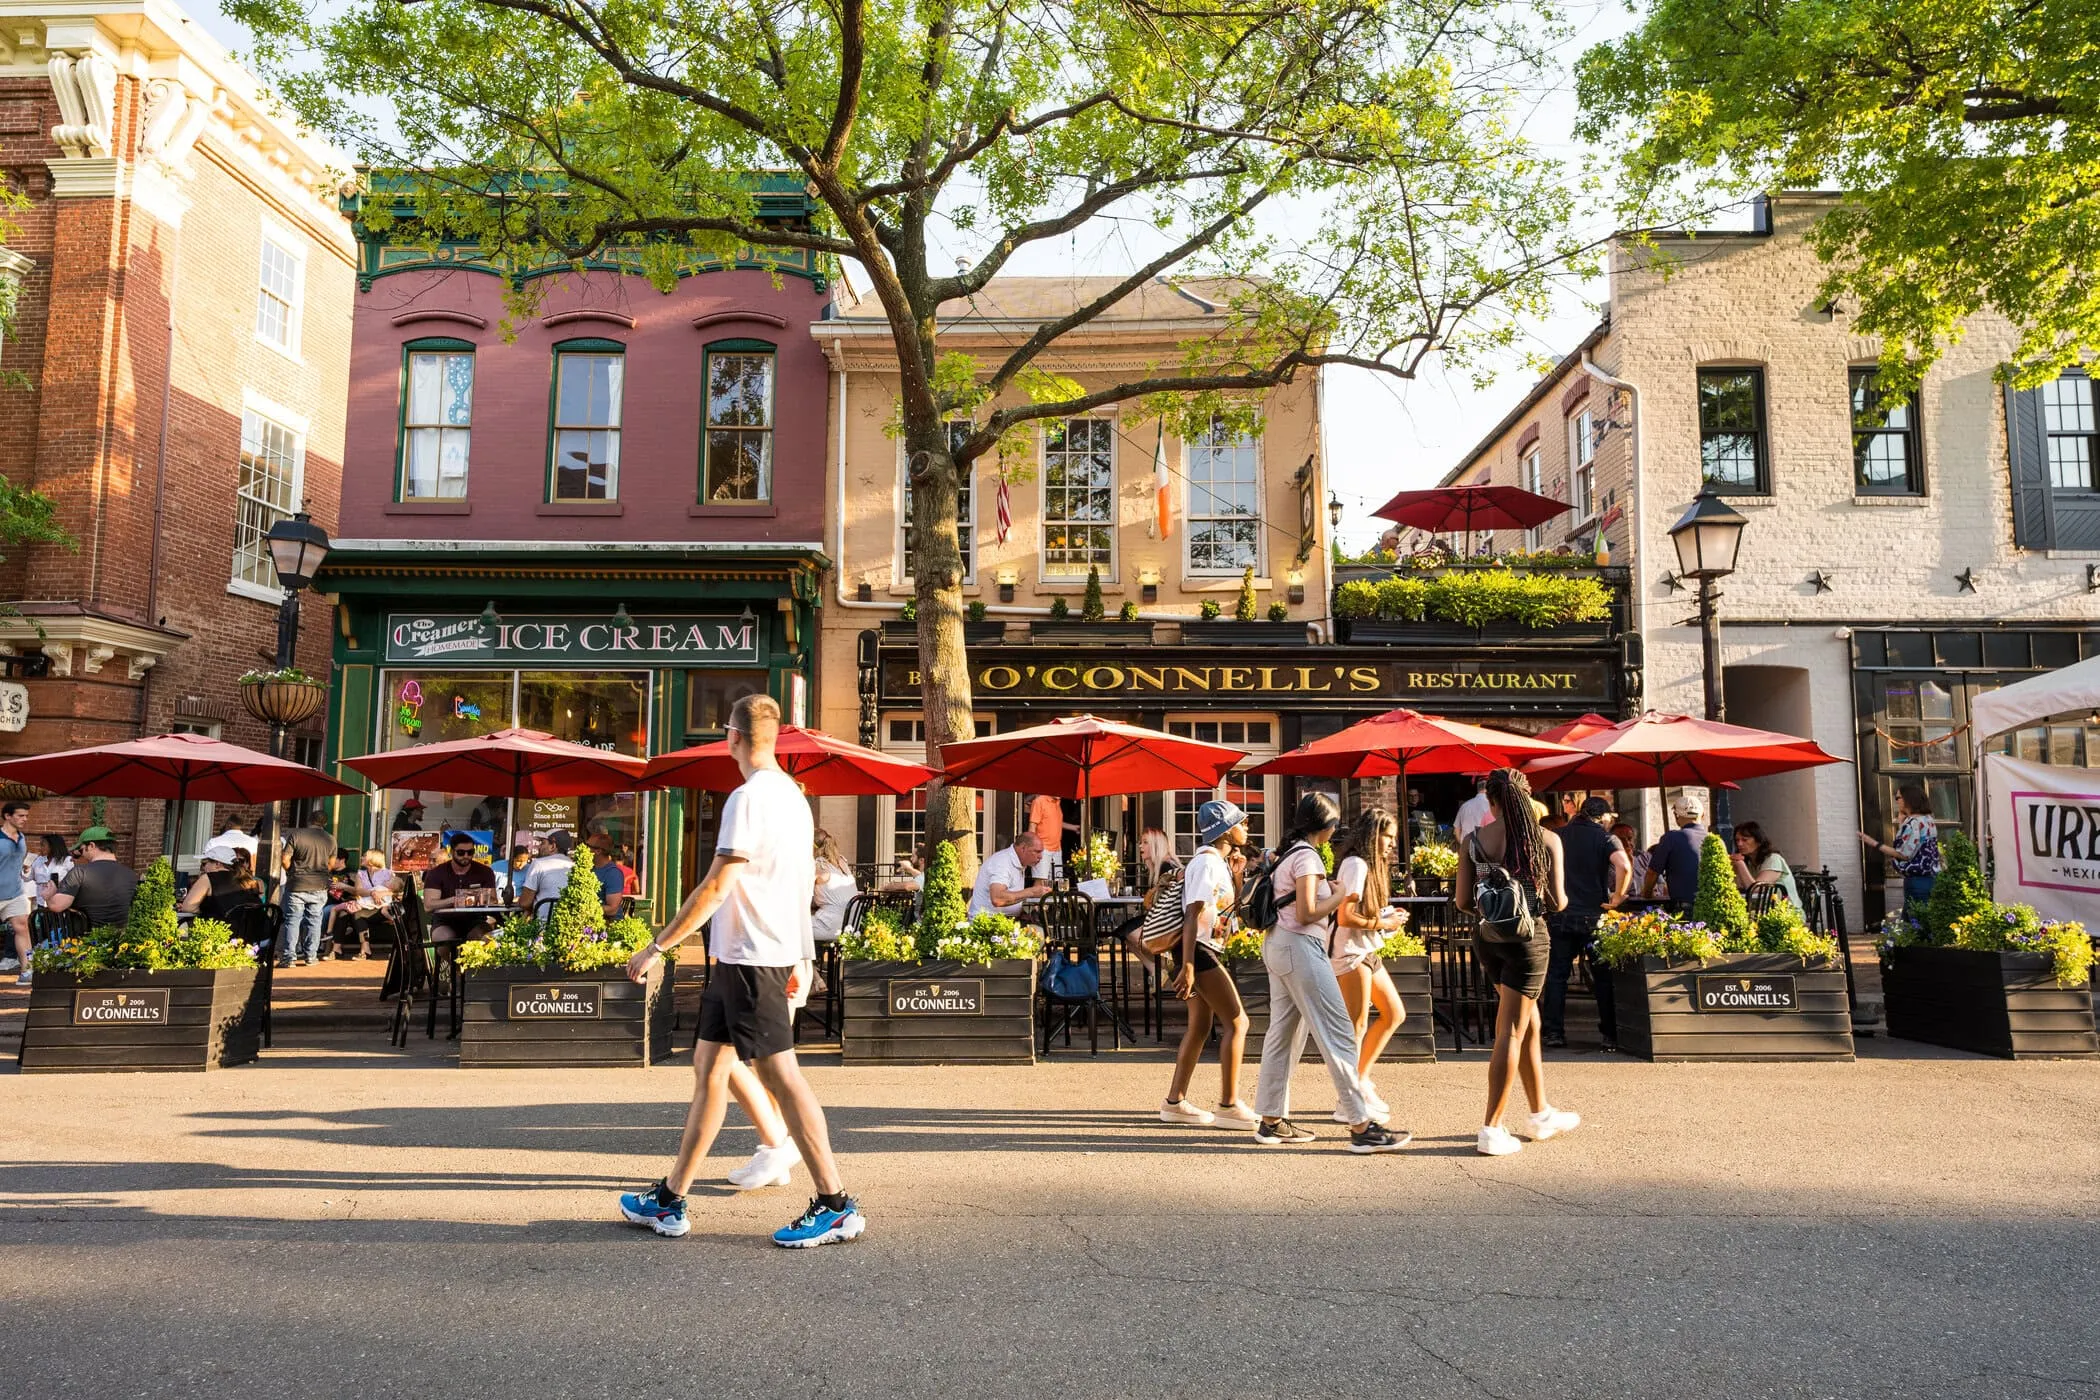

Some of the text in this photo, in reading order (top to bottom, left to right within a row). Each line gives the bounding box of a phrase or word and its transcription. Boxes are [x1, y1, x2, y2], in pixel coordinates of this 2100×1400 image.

[394, 618, 486, 647] Creamery
[495, 624, 754, 651] ICE CREAM
[427, 640, 477, 654] HOMEMADE
[979, 666, 1381, 692] O'CONNELL'S
[1408, 672, 1577, 689] RESTAURANT
[943, 990, 960, 998] 2006
[1705, 993, 1791, 1006] O'CONNELL'S
[516, 1001, 593, 1014] O'CONNELL'S
[896, 997, 976, 1010] O'CONNELL'S
[82, 1007, 160, 1020] O'CONNELL'S
